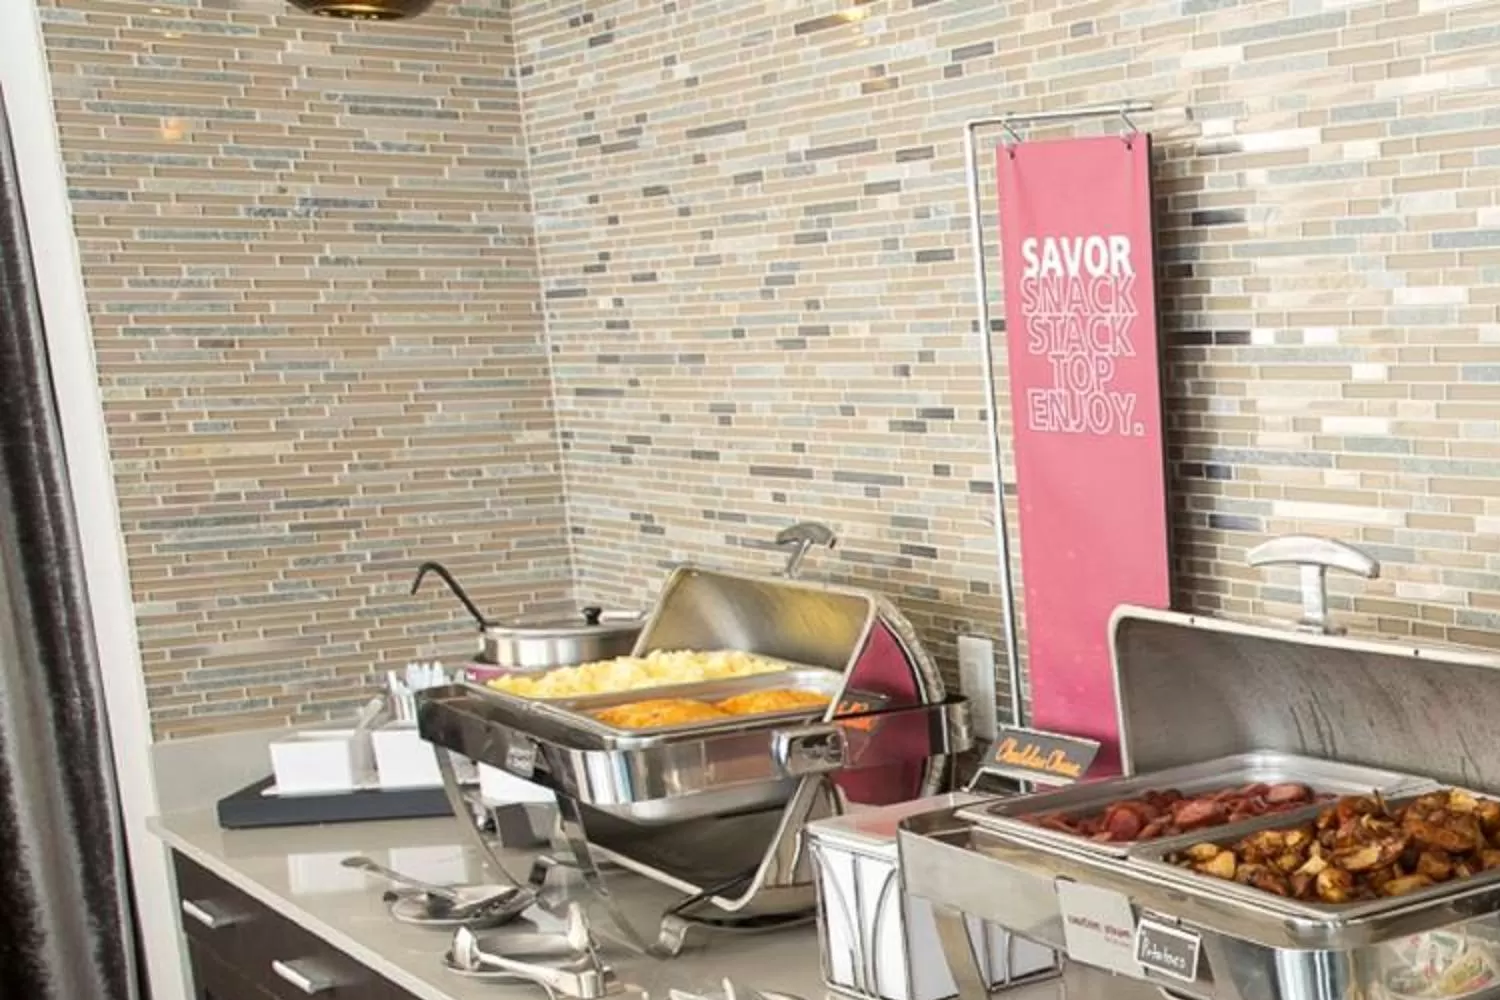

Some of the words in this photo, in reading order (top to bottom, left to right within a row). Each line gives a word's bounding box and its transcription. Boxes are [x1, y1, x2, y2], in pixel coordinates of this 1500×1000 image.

[1021, 235, 1135, 276] SAVOR
[1021, 274, 1138, 317] SNACK
[1028, 312, 1137, 357] STACK
[1049, 352, 1115, 396] TOP
[1028, 387, 1146, 437] ENJOY.
